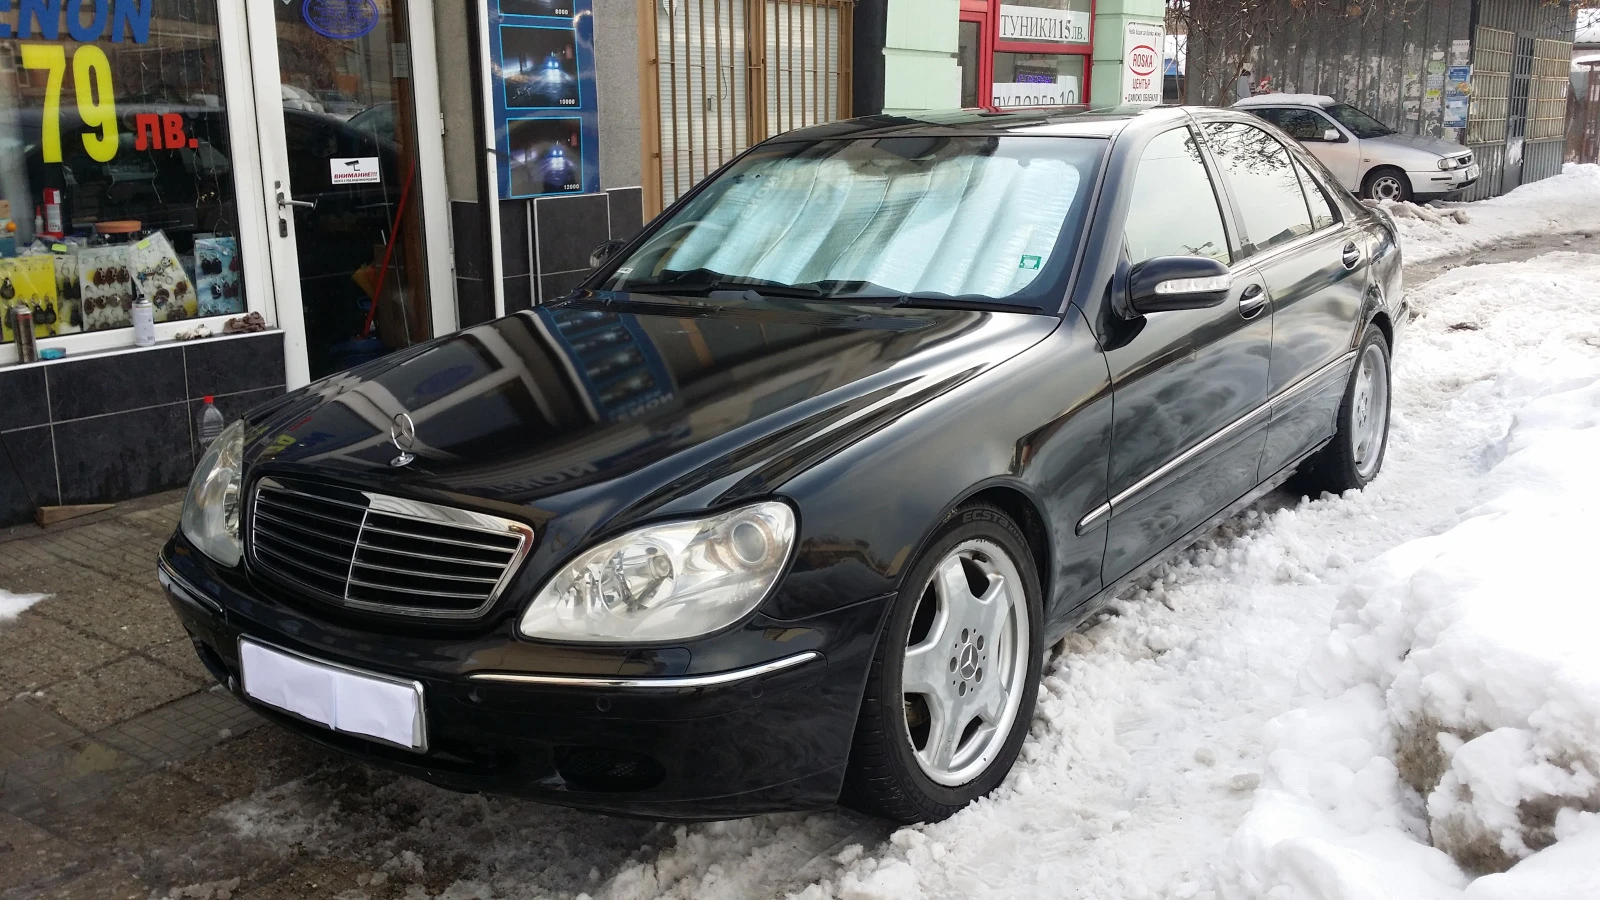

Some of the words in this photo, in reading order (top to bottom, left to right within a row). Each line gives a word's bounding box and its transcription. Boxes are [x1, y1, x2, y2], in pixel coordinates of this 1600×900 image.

[0, 0, 152, 44] NON
[1132, 53, 1153, 68] ROSKA
[1132, 79, 1150, 90] ЦЕНТЪР
[20, 44, 119, 163] 79
